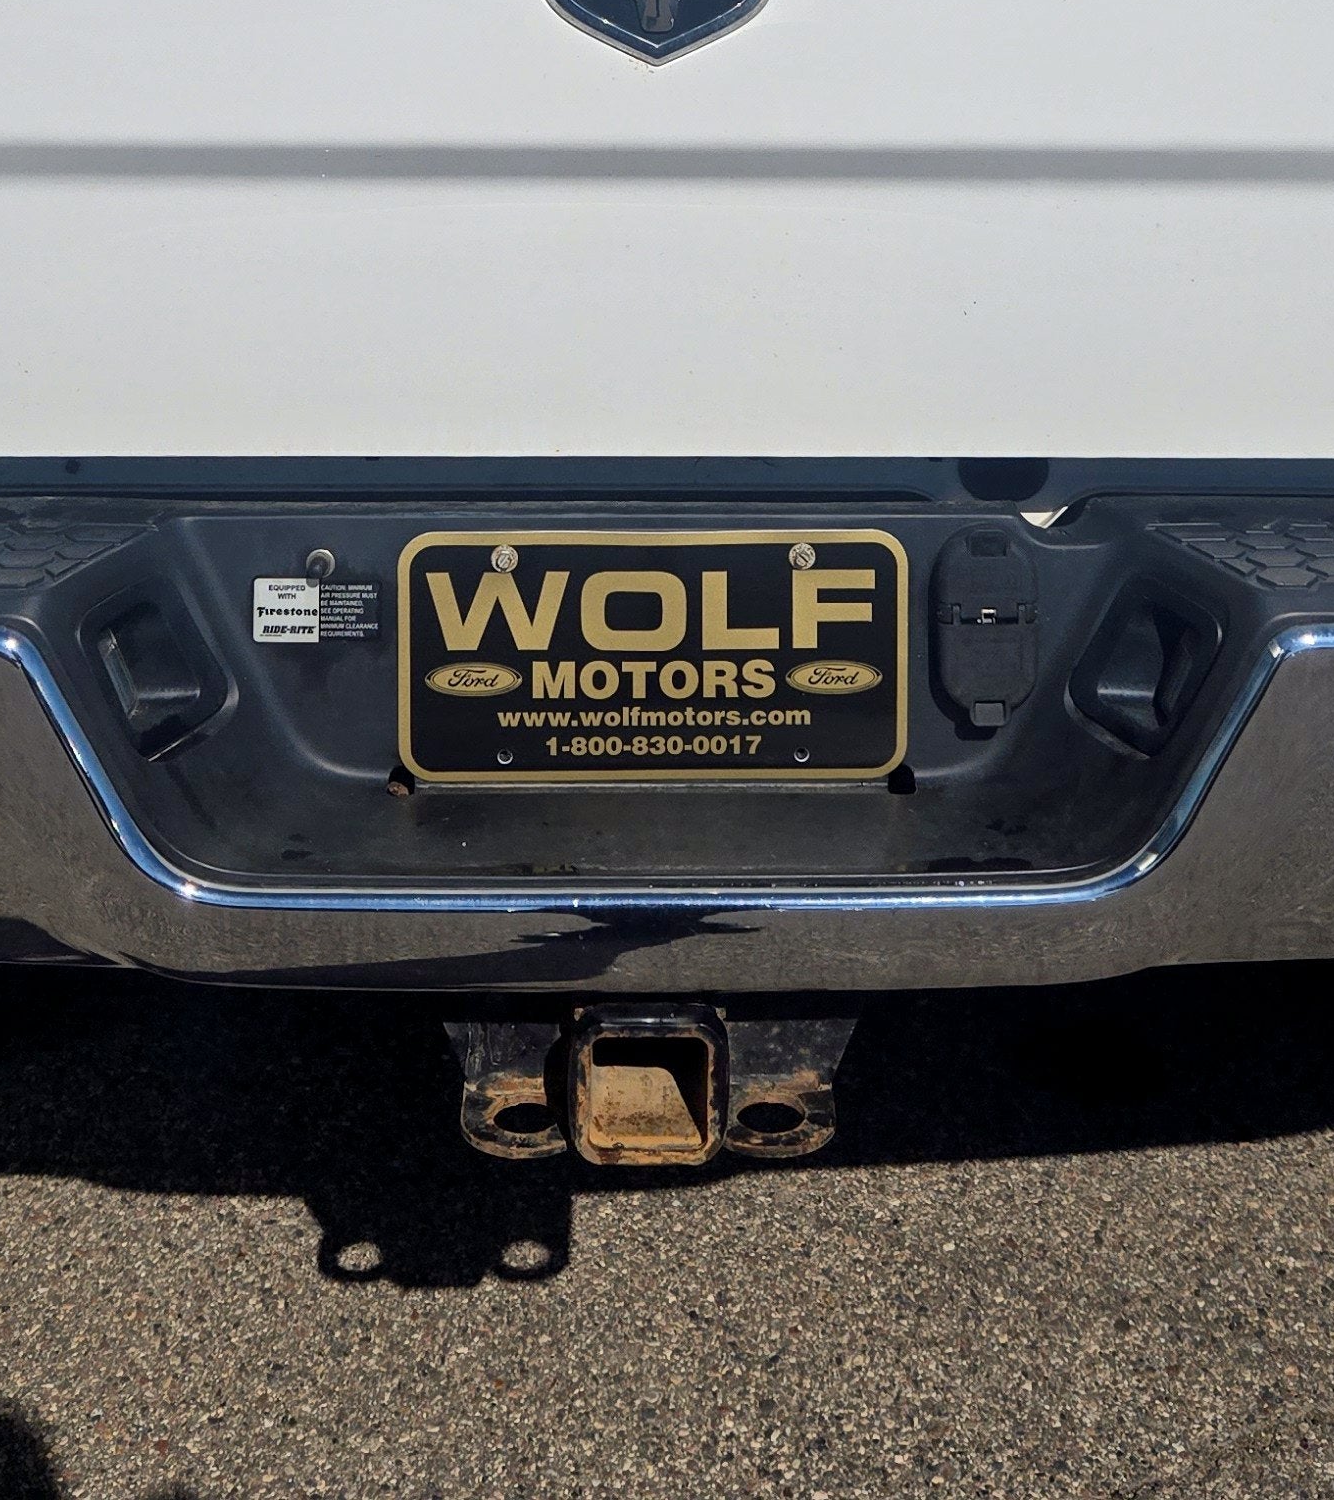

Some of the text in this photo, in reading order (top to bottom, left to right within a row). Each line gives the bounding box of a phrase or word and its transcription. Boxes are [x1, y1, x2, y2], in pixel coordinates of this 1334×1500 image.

[256, 606, 318, 618] Firestone
[425, 569, 877, 652] WOLF
[262, 625, 317, 634] RIDE-RITE
[448, 660, 859, 700] Ford MOTORS Ford
[498, 707, 812, 728] www.wolfmotors.com
[546, 735, 762, 757] 1-800-830-0017
